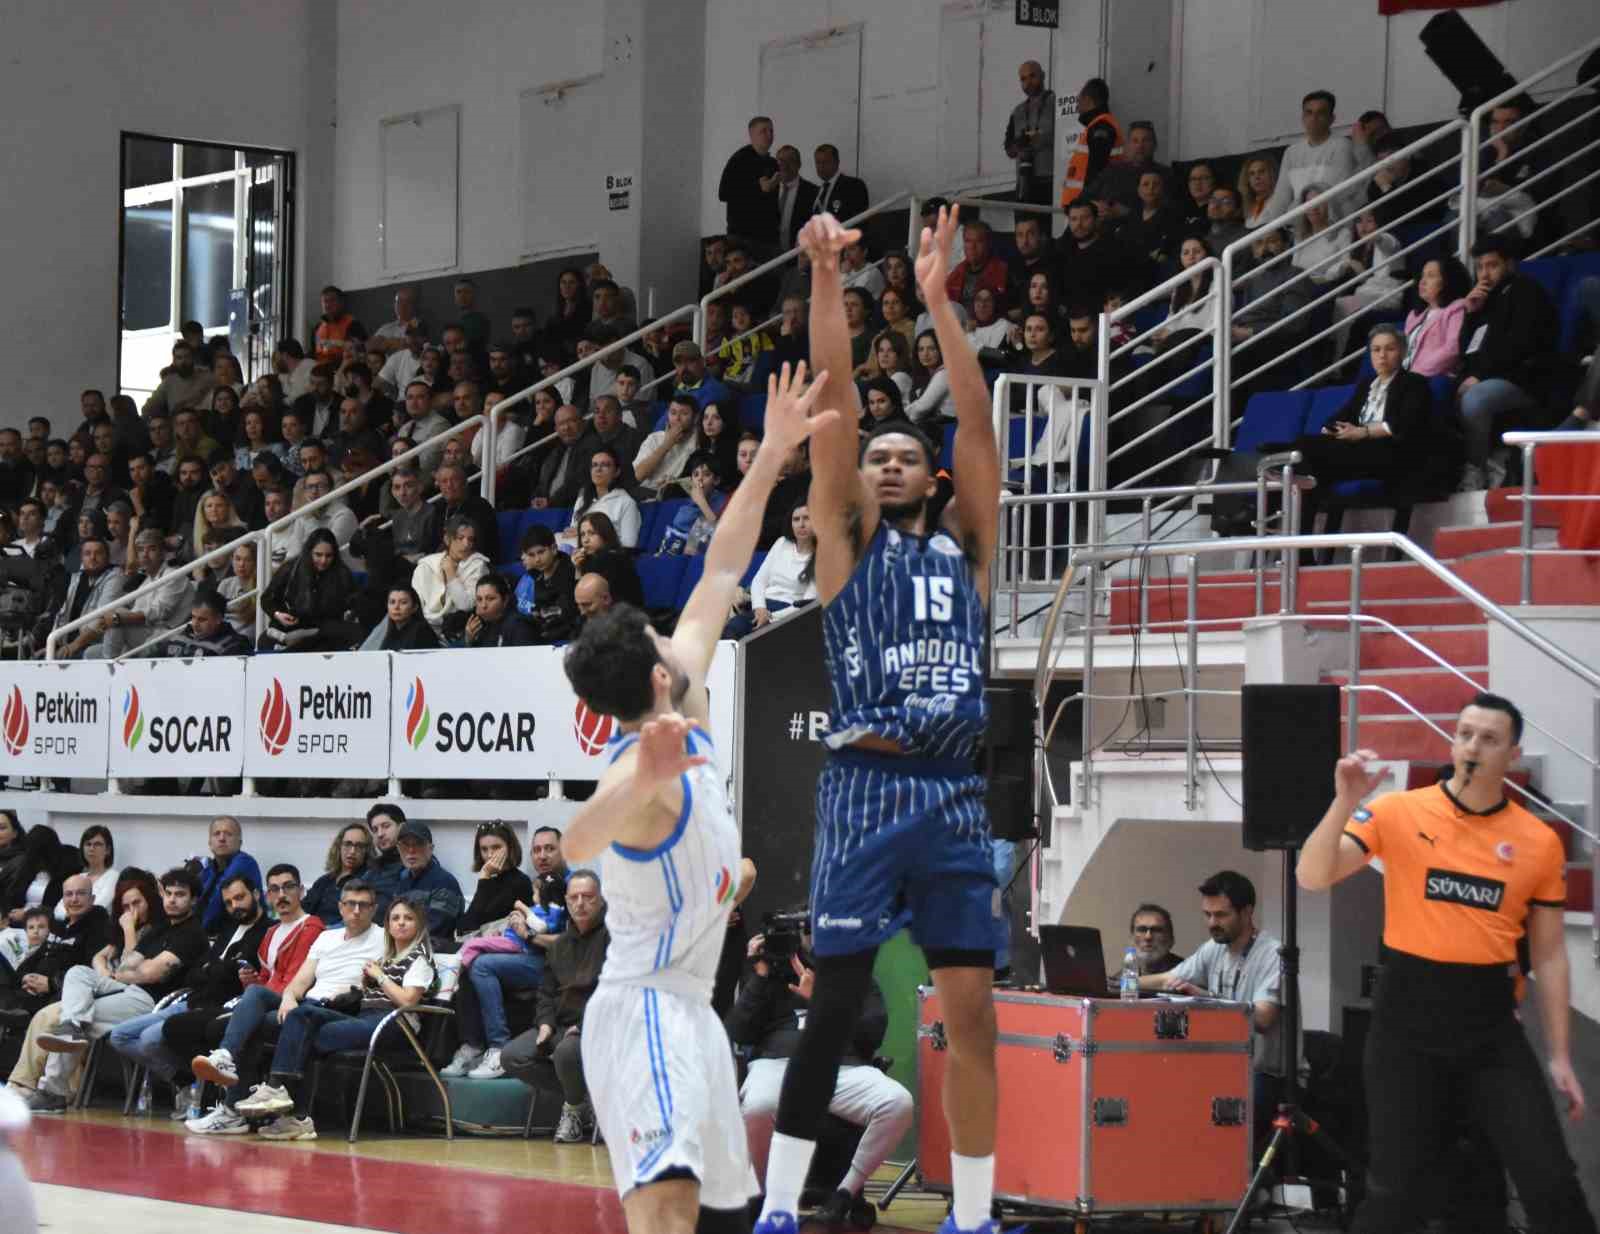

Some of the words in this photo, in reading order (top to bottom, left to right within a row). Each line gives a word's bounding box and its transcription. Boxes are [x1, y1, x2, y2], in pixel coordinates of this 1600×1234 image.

[1020, 0, 1029, 21] B
[1032, 7, 1057, 24] BLOK
[606, 175, 614, 189] B
[616, 176, 633, 188] BLOK
[911, 576, 953, 622] 15
[898, 665, 970, 692] EFES
[35, 691, 97, 724] Petkim
[299, 684, 372, 720] Petkim
[34, 736, 77, 754] SPOR
[148, 715, 232, 754] SOCAR
[297, 734, 348, 753] SPOR
[435, 711, 536, 753] SOCAR
